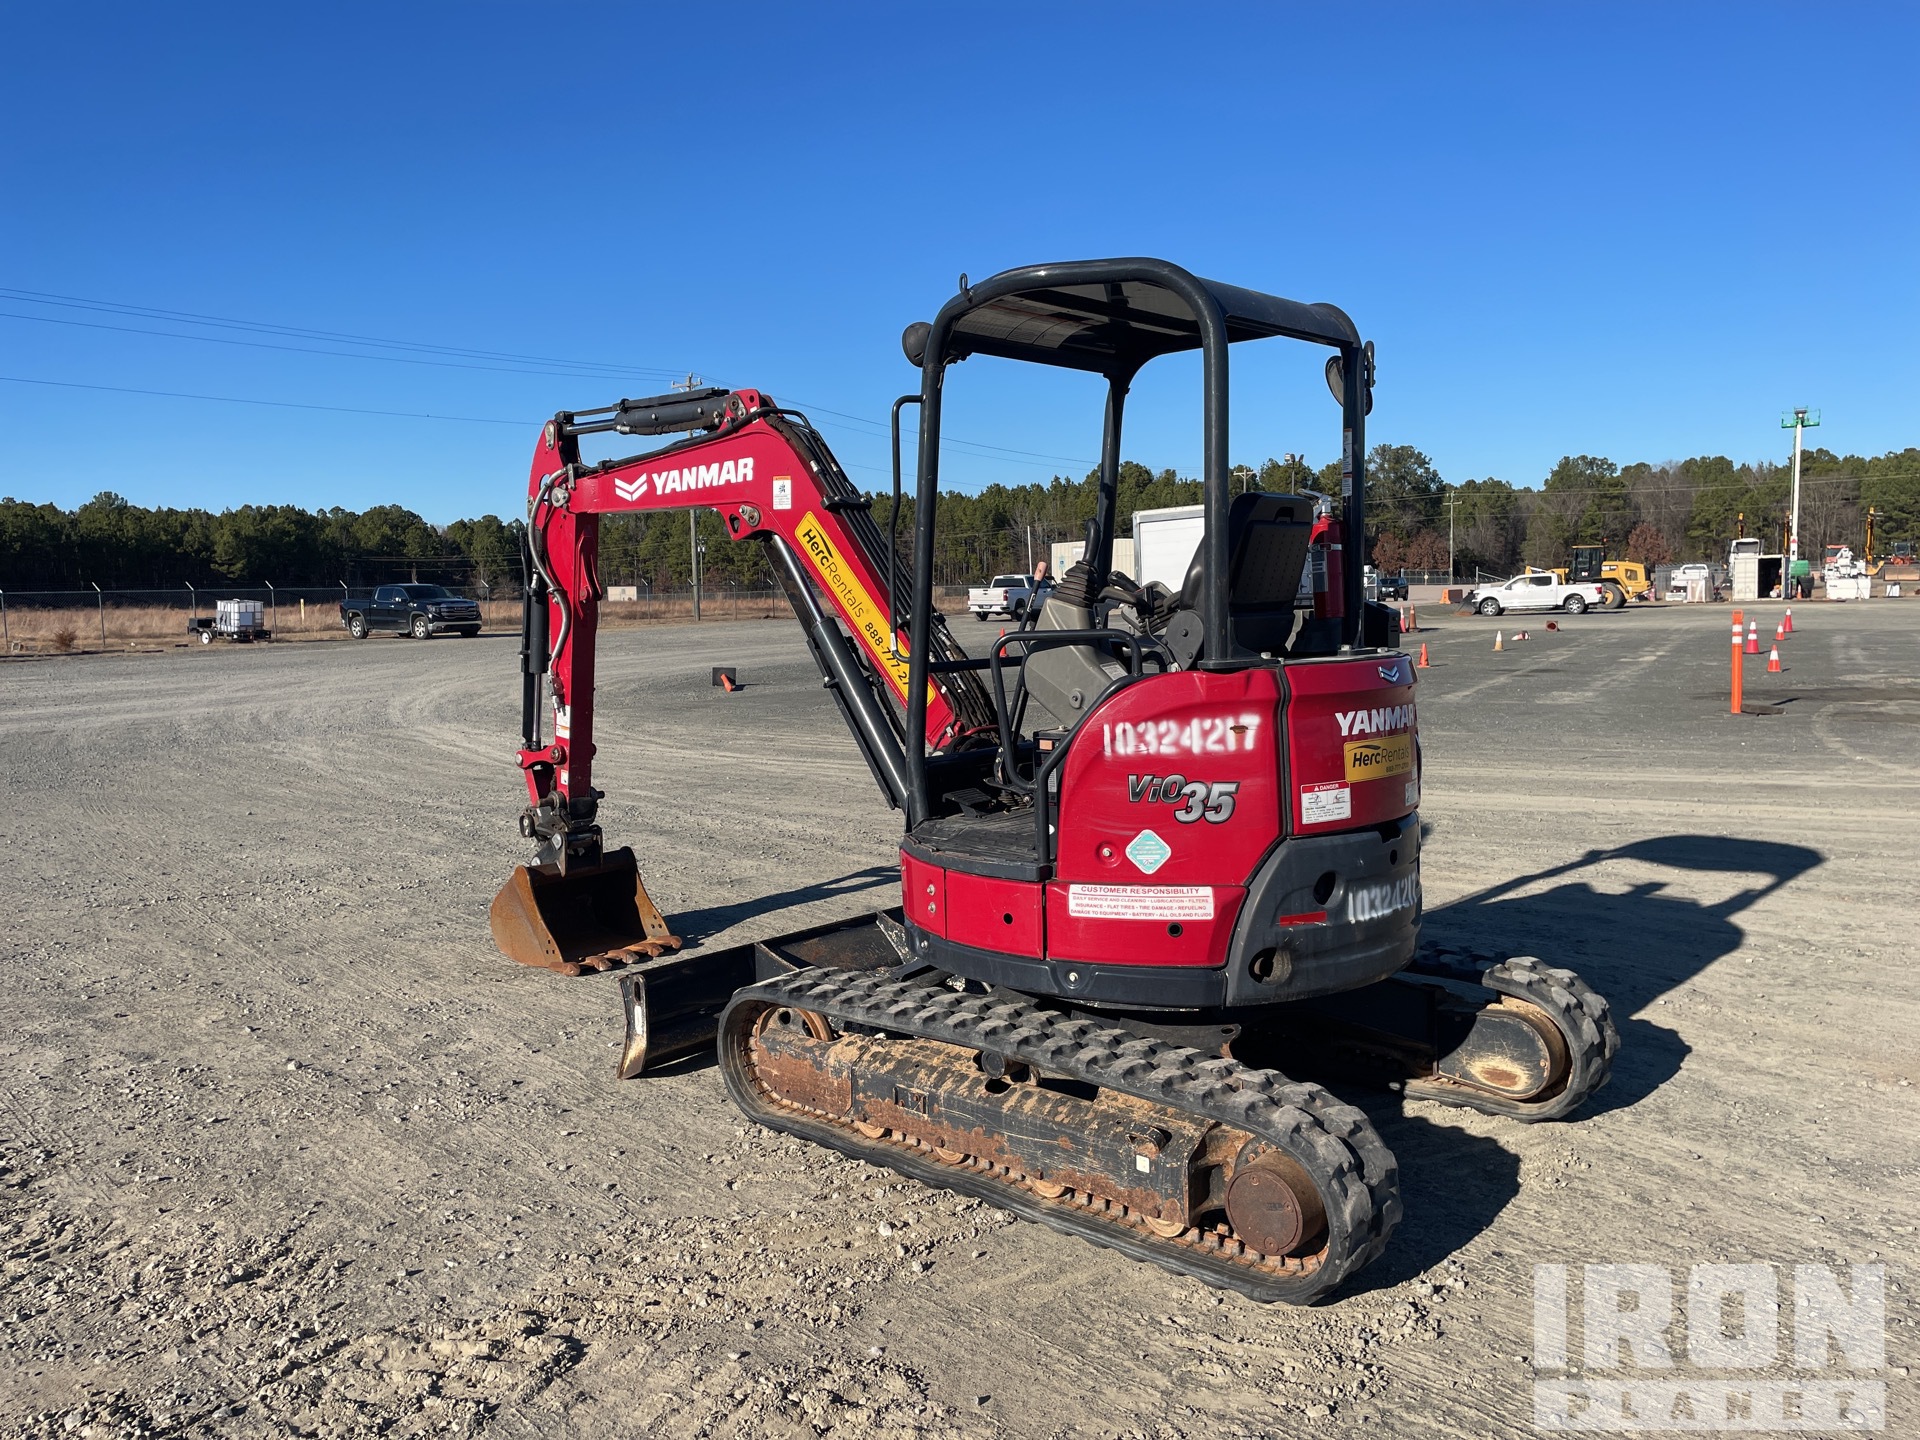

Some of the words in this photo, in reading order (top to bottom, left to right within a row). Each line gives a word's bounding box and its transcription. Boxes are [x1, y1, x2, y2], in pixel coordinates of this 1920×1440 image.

[651, 457, 754, 495] YANMAR
[1335, 703, 1415, 736] YANMAR
[1081, 886, 1128, 894] CUSTOMER
